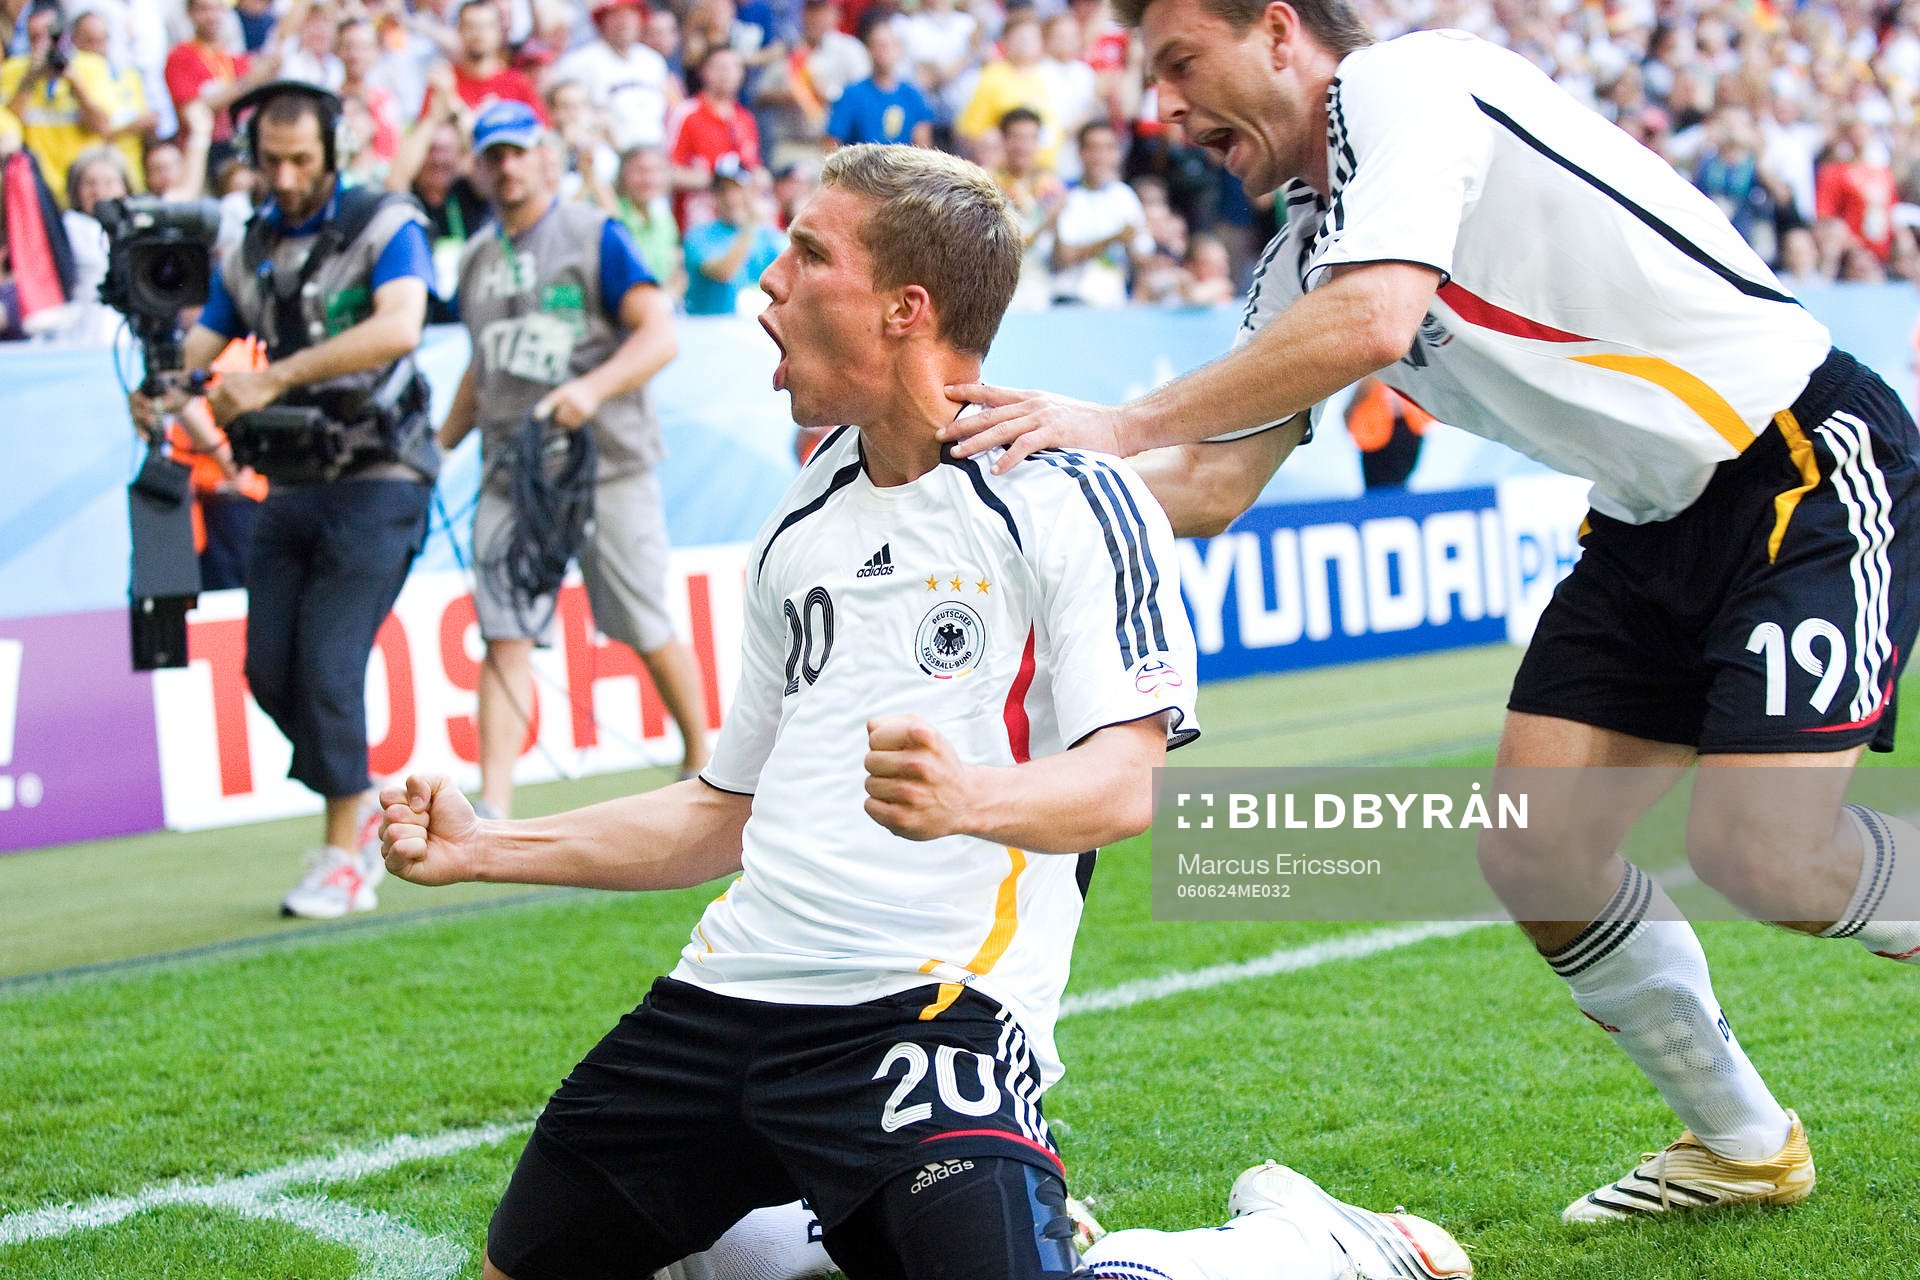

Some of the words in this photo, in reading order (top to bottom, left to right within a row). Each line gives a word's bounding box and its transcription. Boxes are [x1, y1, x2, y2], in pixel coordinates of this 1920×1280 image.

[856, 564, 895, 578] adidas
[932, 610, 972, 628] DEUTSCHER
[784, 586, 834, 697] 20
[923, 646, 973, 670] FUSSBALL-BUND
[1745, 617, 1848, 716] 19
[872, 1041, 1002, 1133] 20
[911, 1159, 975, 1194] adidas
